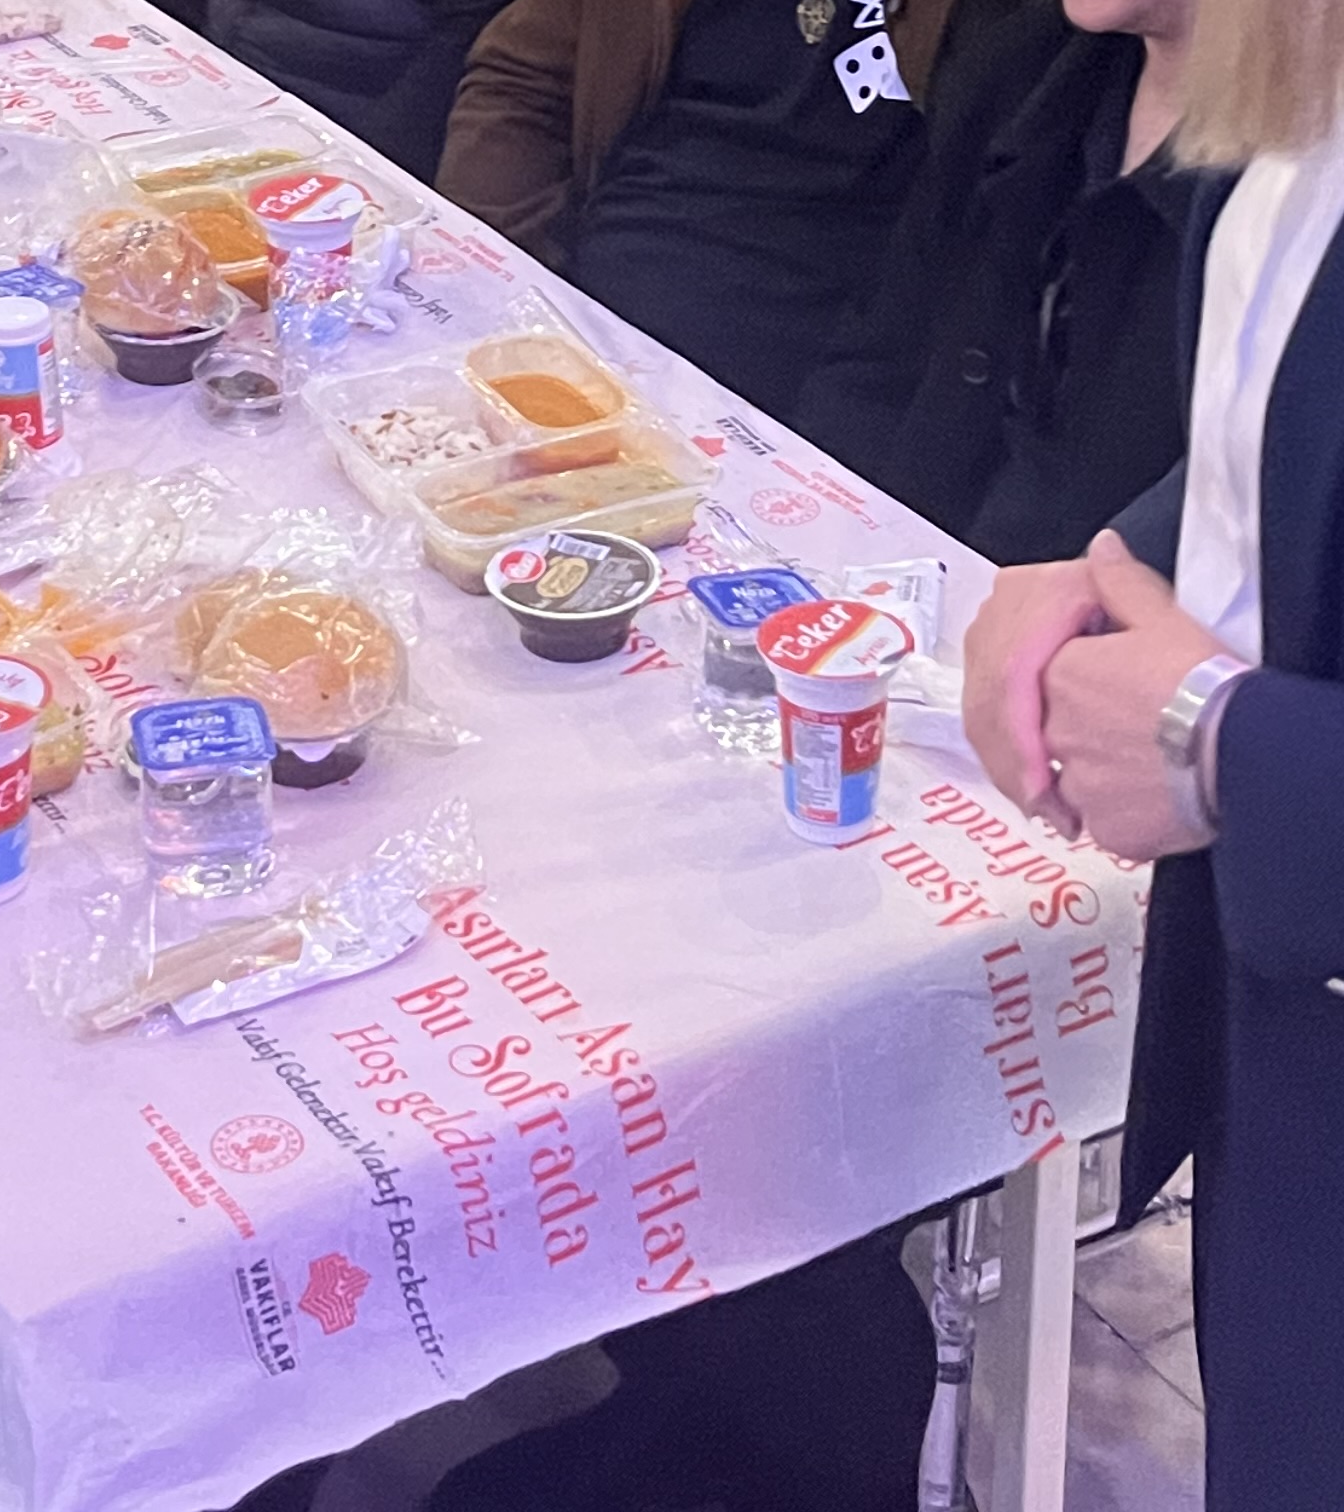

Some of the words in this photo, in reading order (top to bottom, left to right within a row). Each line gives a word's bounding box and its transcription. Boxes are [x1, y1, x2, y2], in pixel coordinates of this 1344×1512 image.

[919, 783, 1101, 929] Sofrada
[1055, 944, 1116, 1038] Bu
[330, 1022, 409, 1089] Hoş
[375, 1091, 499, 1259] geldiniz
[391, 974, 473, 1040] Bu
[447, 1034, 600, 1268] Sofrada
[556, 1021, 672, 1157] Aşan
[351, 1139, 413, 1208] Vakıf
[249, 1257, 297, 1374] VAKIFLAR
